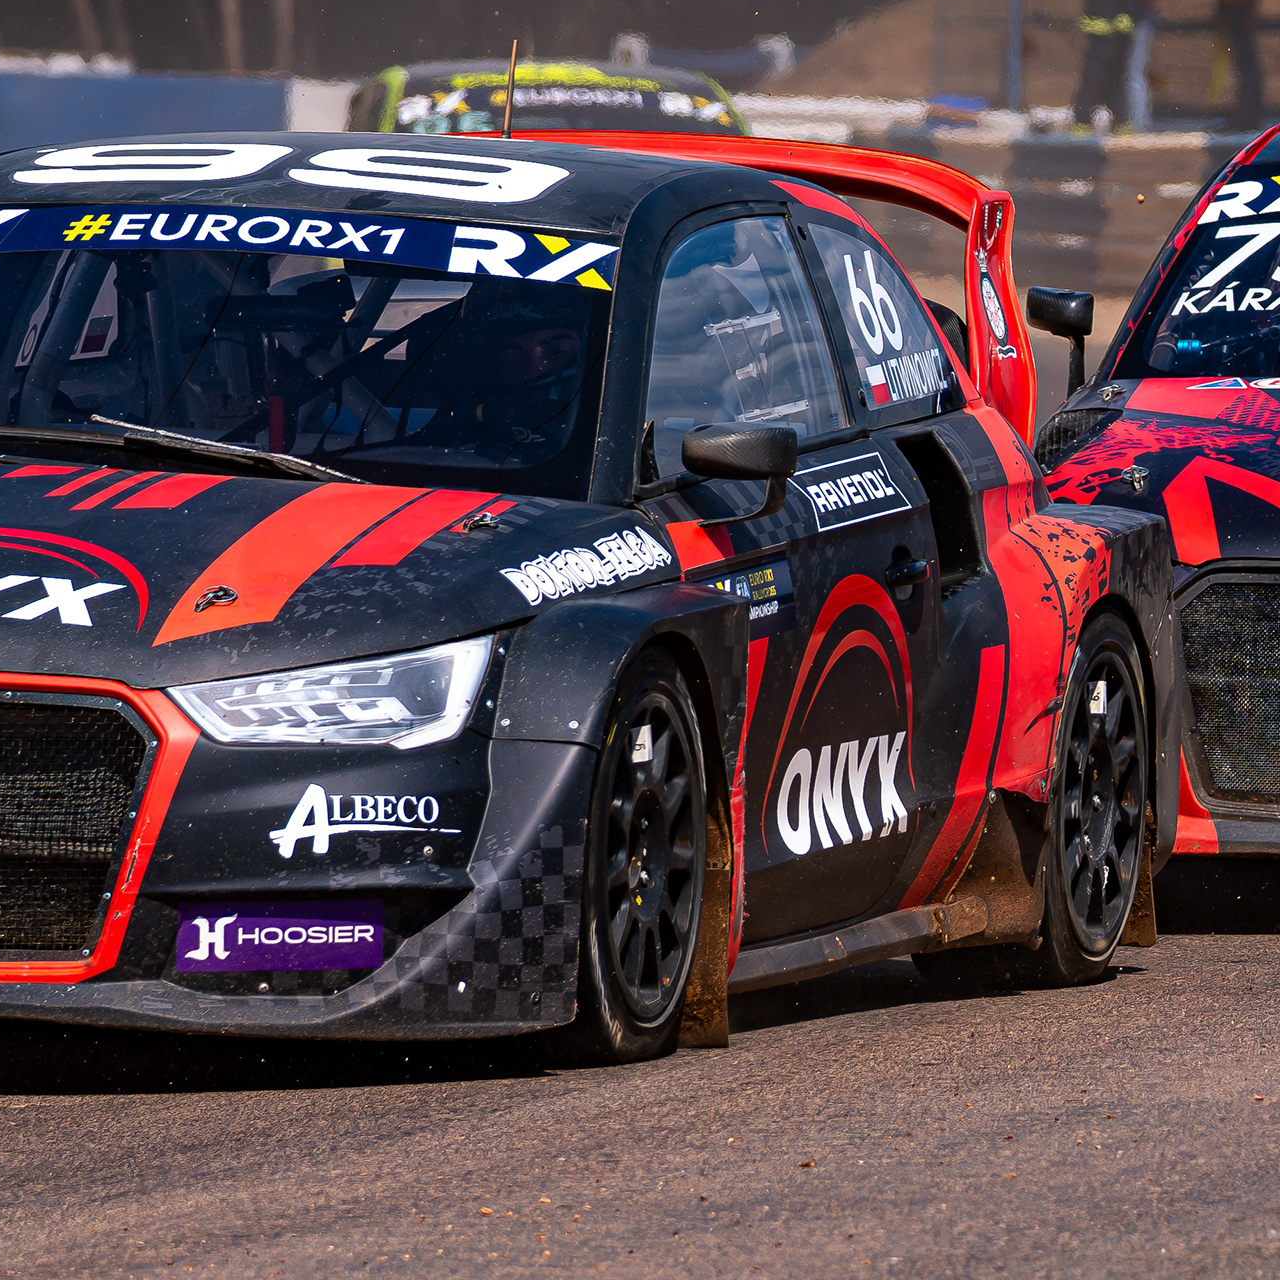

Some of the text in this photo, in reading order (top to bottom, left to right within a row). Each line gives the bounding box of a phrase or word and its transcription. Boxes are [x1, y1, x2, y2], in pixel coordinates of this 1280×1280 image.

[62, 213, 406, 255] #EURORX1
[447, 226, 620, 291] RX
[843, 250, 904, 355] 66
[806, 469, 896, 512] RAVENOL
[269, 782, 448, 858] ALBECO
[777, 731, 908, 855] ONYX
[237, 925, 375, 945] HOOSIER
